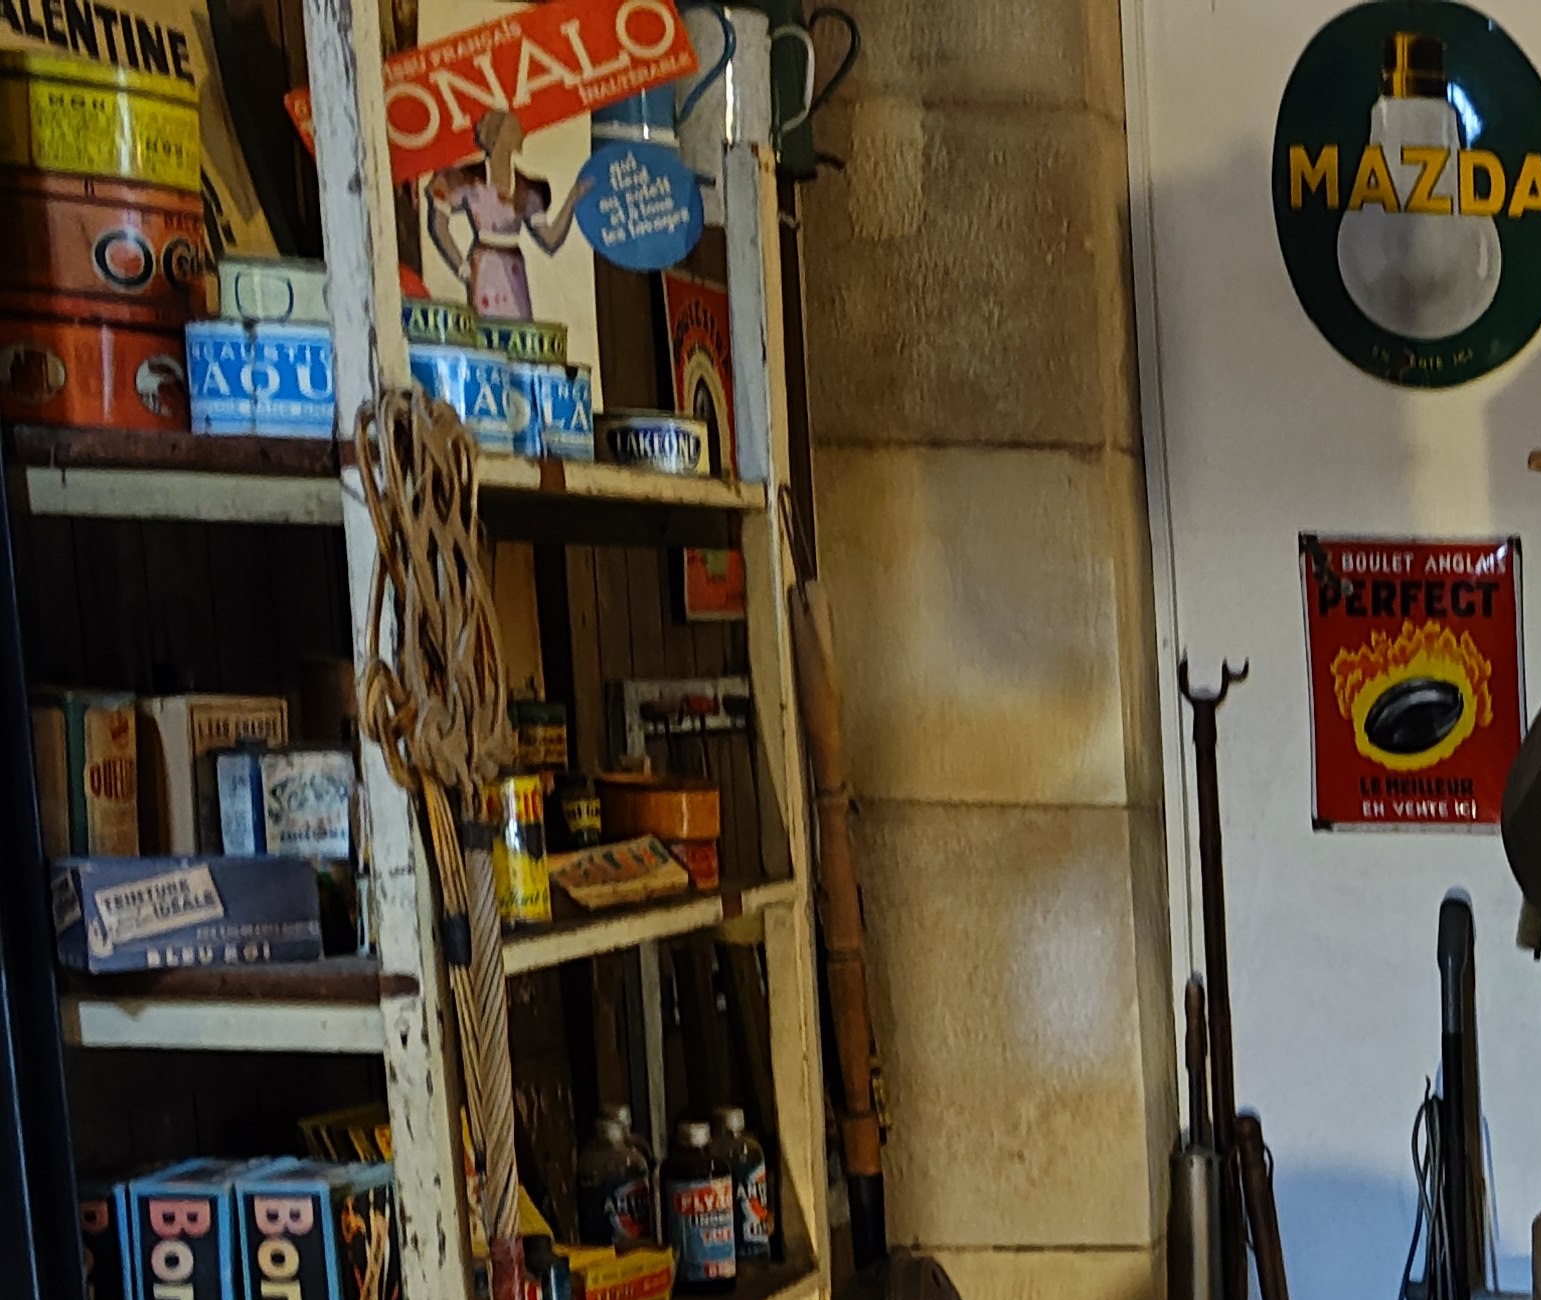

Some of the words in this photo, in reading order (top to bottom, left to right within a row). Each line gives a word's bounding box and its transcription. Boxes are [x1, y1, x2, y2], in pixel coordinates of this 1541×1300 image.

[386, 0, 675, 149] ONALO
[1341, 551, 1415, 575] BOULET
[1424, 552, 1507, 576] ANGLAIS
[1317, 577, 1500, 619] PERFECT
[1359, 775, 1382, 797] LE
[1385, 776, 1475, 797] MEILLEUR
[1362, 799, 1386, 818] EN
[1393, 799, 1449, 818] VENTE
[1454, 799, 1478, 820] ICI
